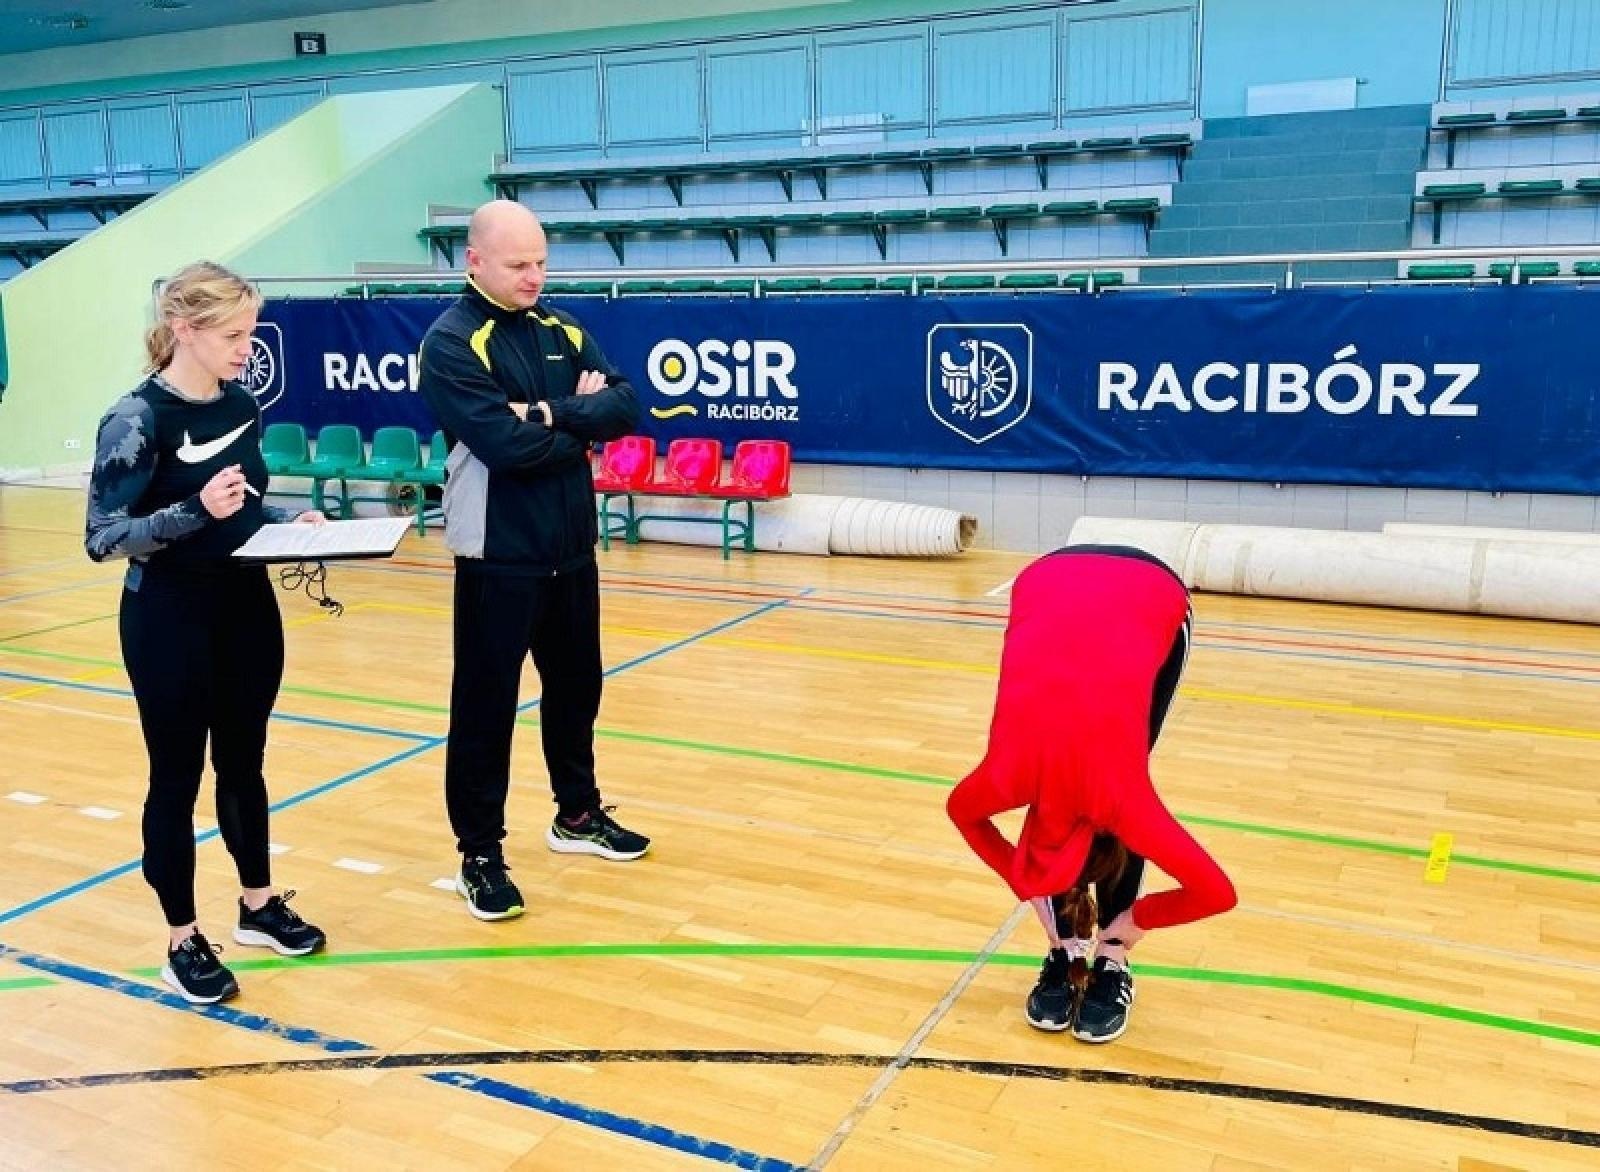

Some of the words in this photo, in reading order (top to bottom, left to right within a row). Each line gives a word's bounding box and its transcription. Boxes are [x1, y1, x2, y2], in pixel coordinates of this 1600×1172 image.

[323, 352, 420, 393] RACI
[1097, 344, 1481, 417] RACIBÓRZ
[707, 400, 799, 421] RACIBÓRZ
